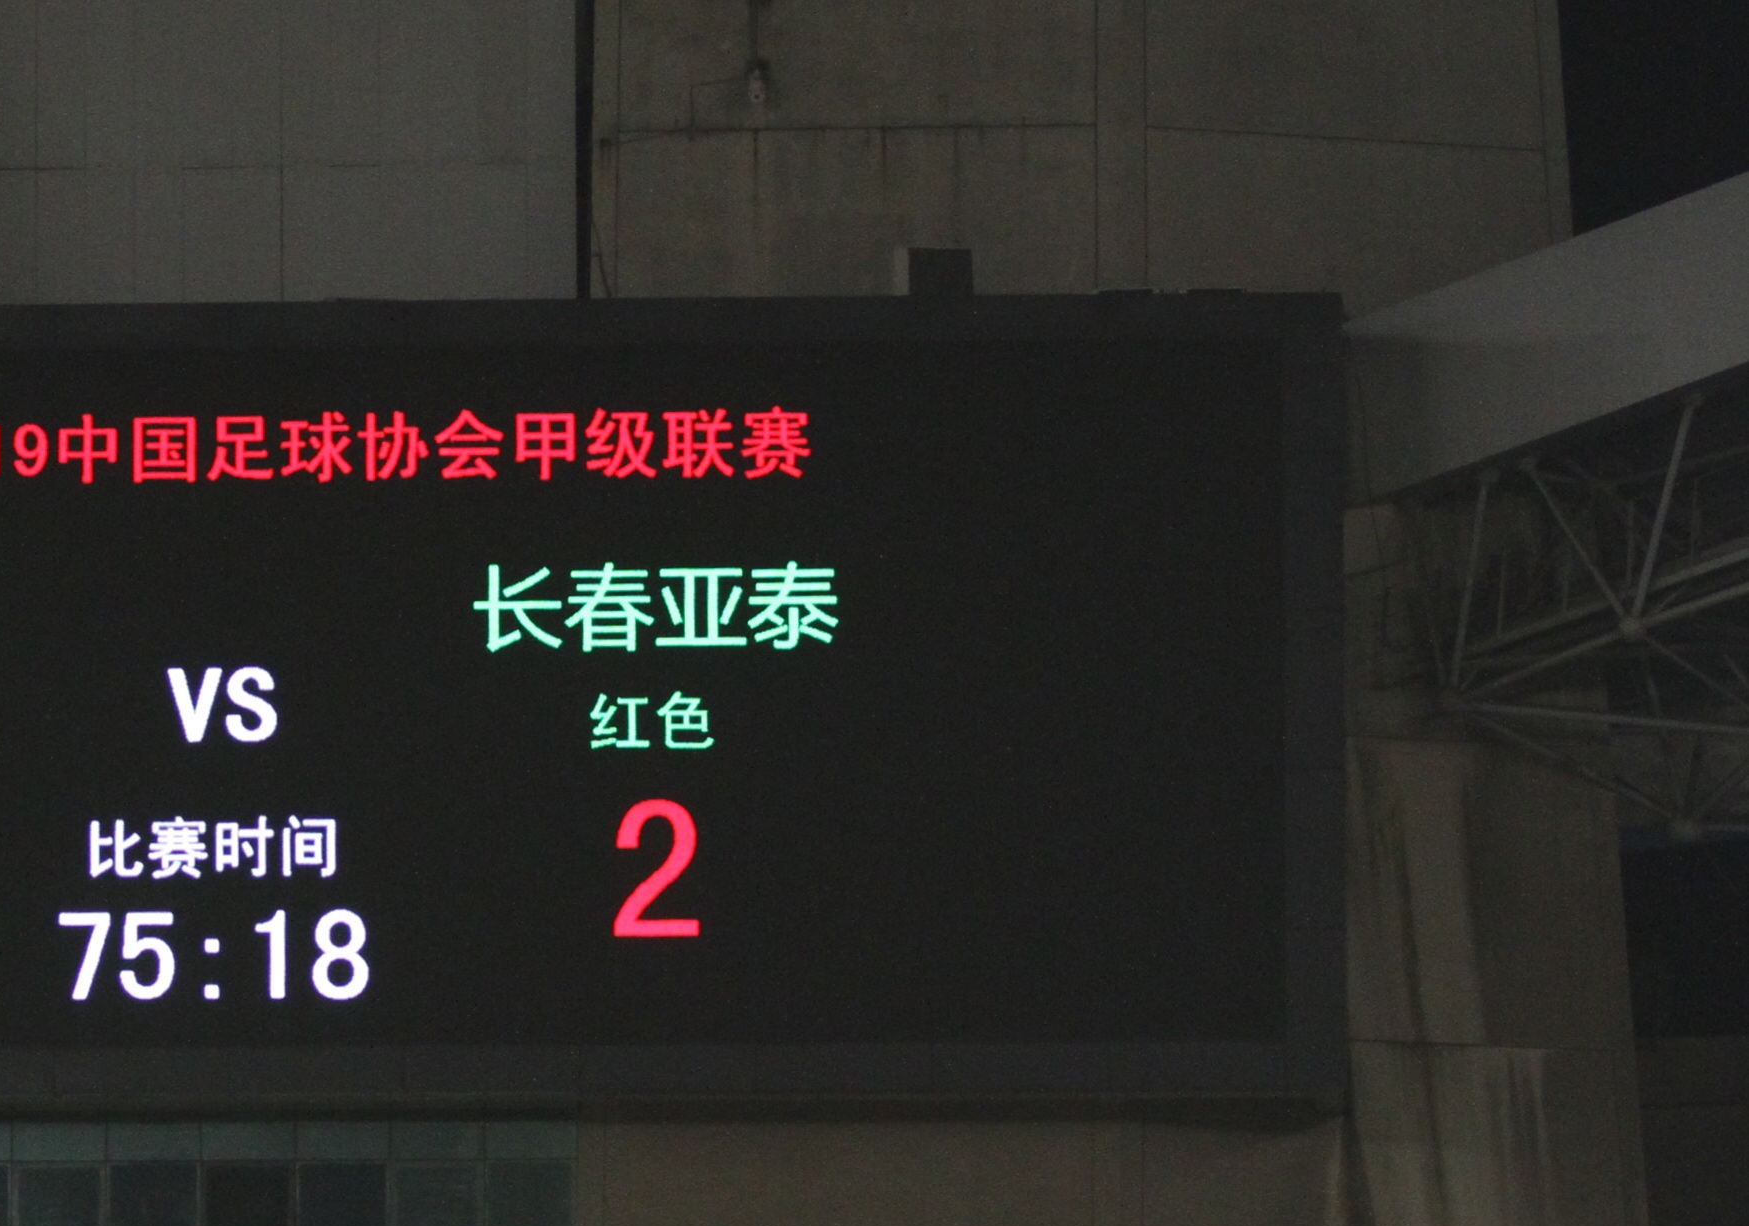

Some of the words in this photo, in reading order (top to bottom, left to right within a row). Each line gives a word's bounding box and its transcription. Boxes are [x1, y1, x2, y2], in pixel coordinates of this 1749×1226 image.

[472, 560, 839, 653] 长春亚泰
[166, 665, 279, 744] VS
[589, 690, 715, 750] 红色
[87, 814, 338, 880] 比赛时间
[612, 798, 701, 938] 2
